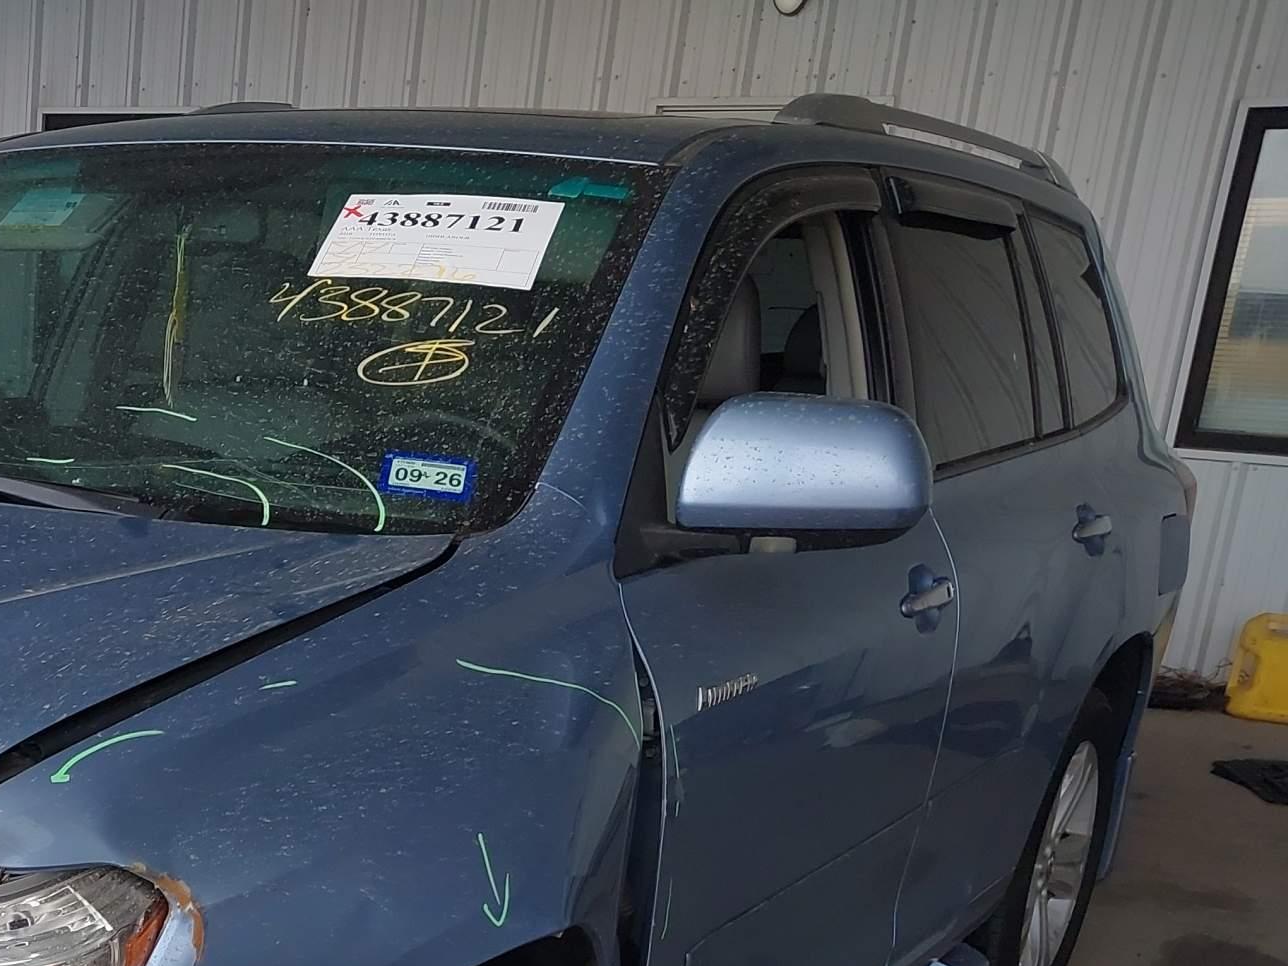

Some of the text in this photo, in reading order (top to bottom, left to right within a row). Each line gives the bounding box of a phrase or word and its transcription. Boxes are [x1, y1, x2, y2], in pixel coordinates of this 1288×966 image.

[357, 211, 525, 233] 43887121
[268, 279, 560, 338] 43887121
[395, 467, 462, 488] 09 26
